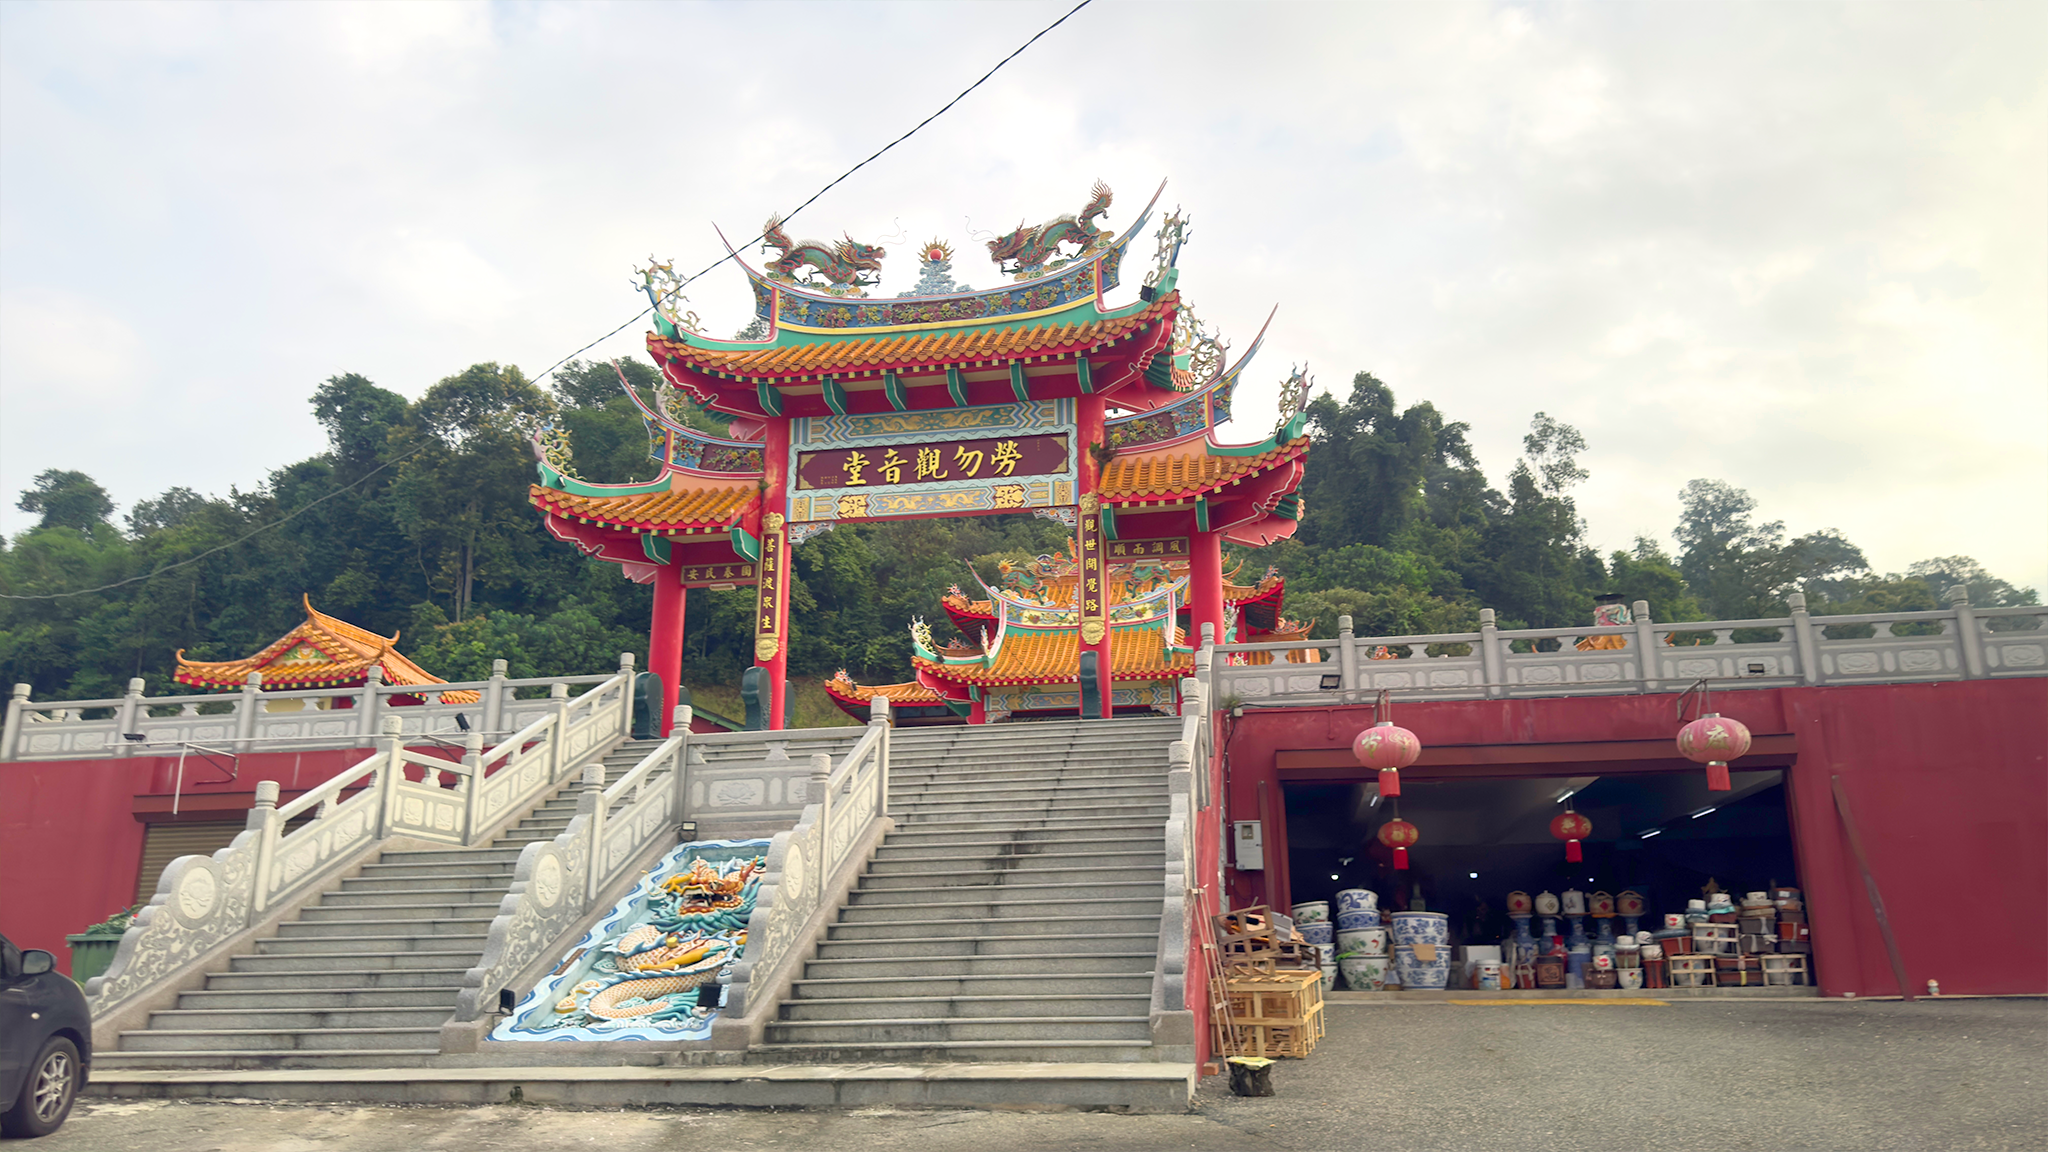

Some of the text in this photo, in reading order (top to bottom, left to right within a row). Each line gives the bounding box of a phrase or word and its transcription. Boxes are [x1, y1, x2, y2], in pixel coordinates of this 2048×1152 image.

[842, 440, 1023, 486] 勞勿觀音堂
[1113, 540, 1182, 556] 風調雨順
[687, 565, 752, 580] 國泰民安
